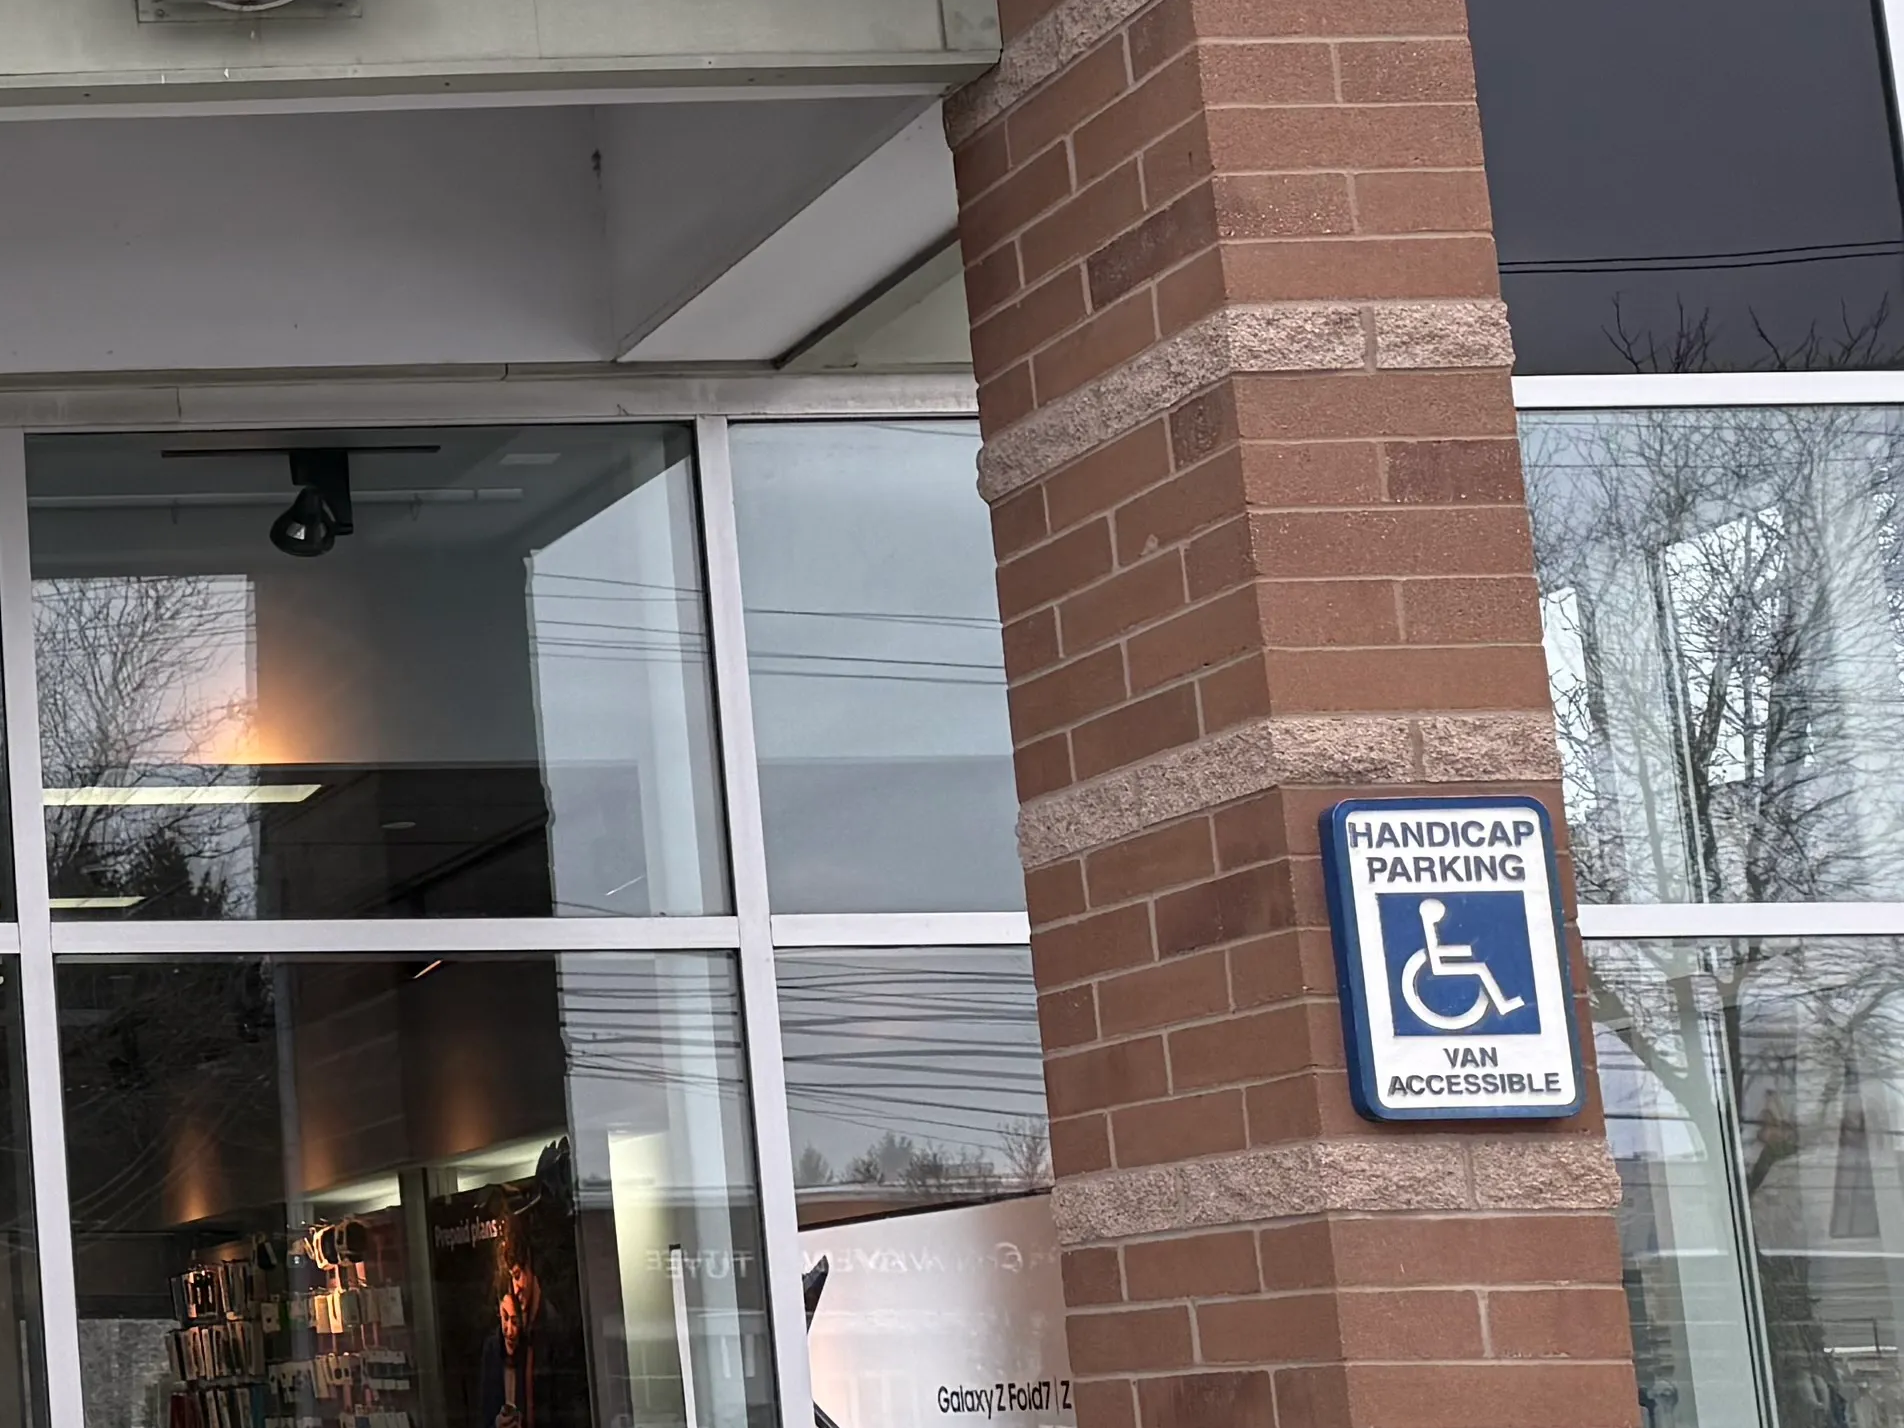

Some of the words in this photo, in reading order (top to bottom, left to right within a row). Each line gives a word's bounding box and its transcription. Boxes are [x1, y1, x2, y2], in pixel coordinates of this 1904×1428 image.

[1347, 820, 1535, 849] HANDICAP
[1366, 854, 1526, 883] PARKING
[1443, 1046, 1499, 1069] VAN
[1387, 1072, 1562, 1097] ACCESSIBLE
[937, 1385, 994, 1420] Galaxy
[995, 1383, 1007, 1412] Z
[1009, 1380, 1052, 1411] Fold7
[1060, 1380, 1072, 1410] Z
